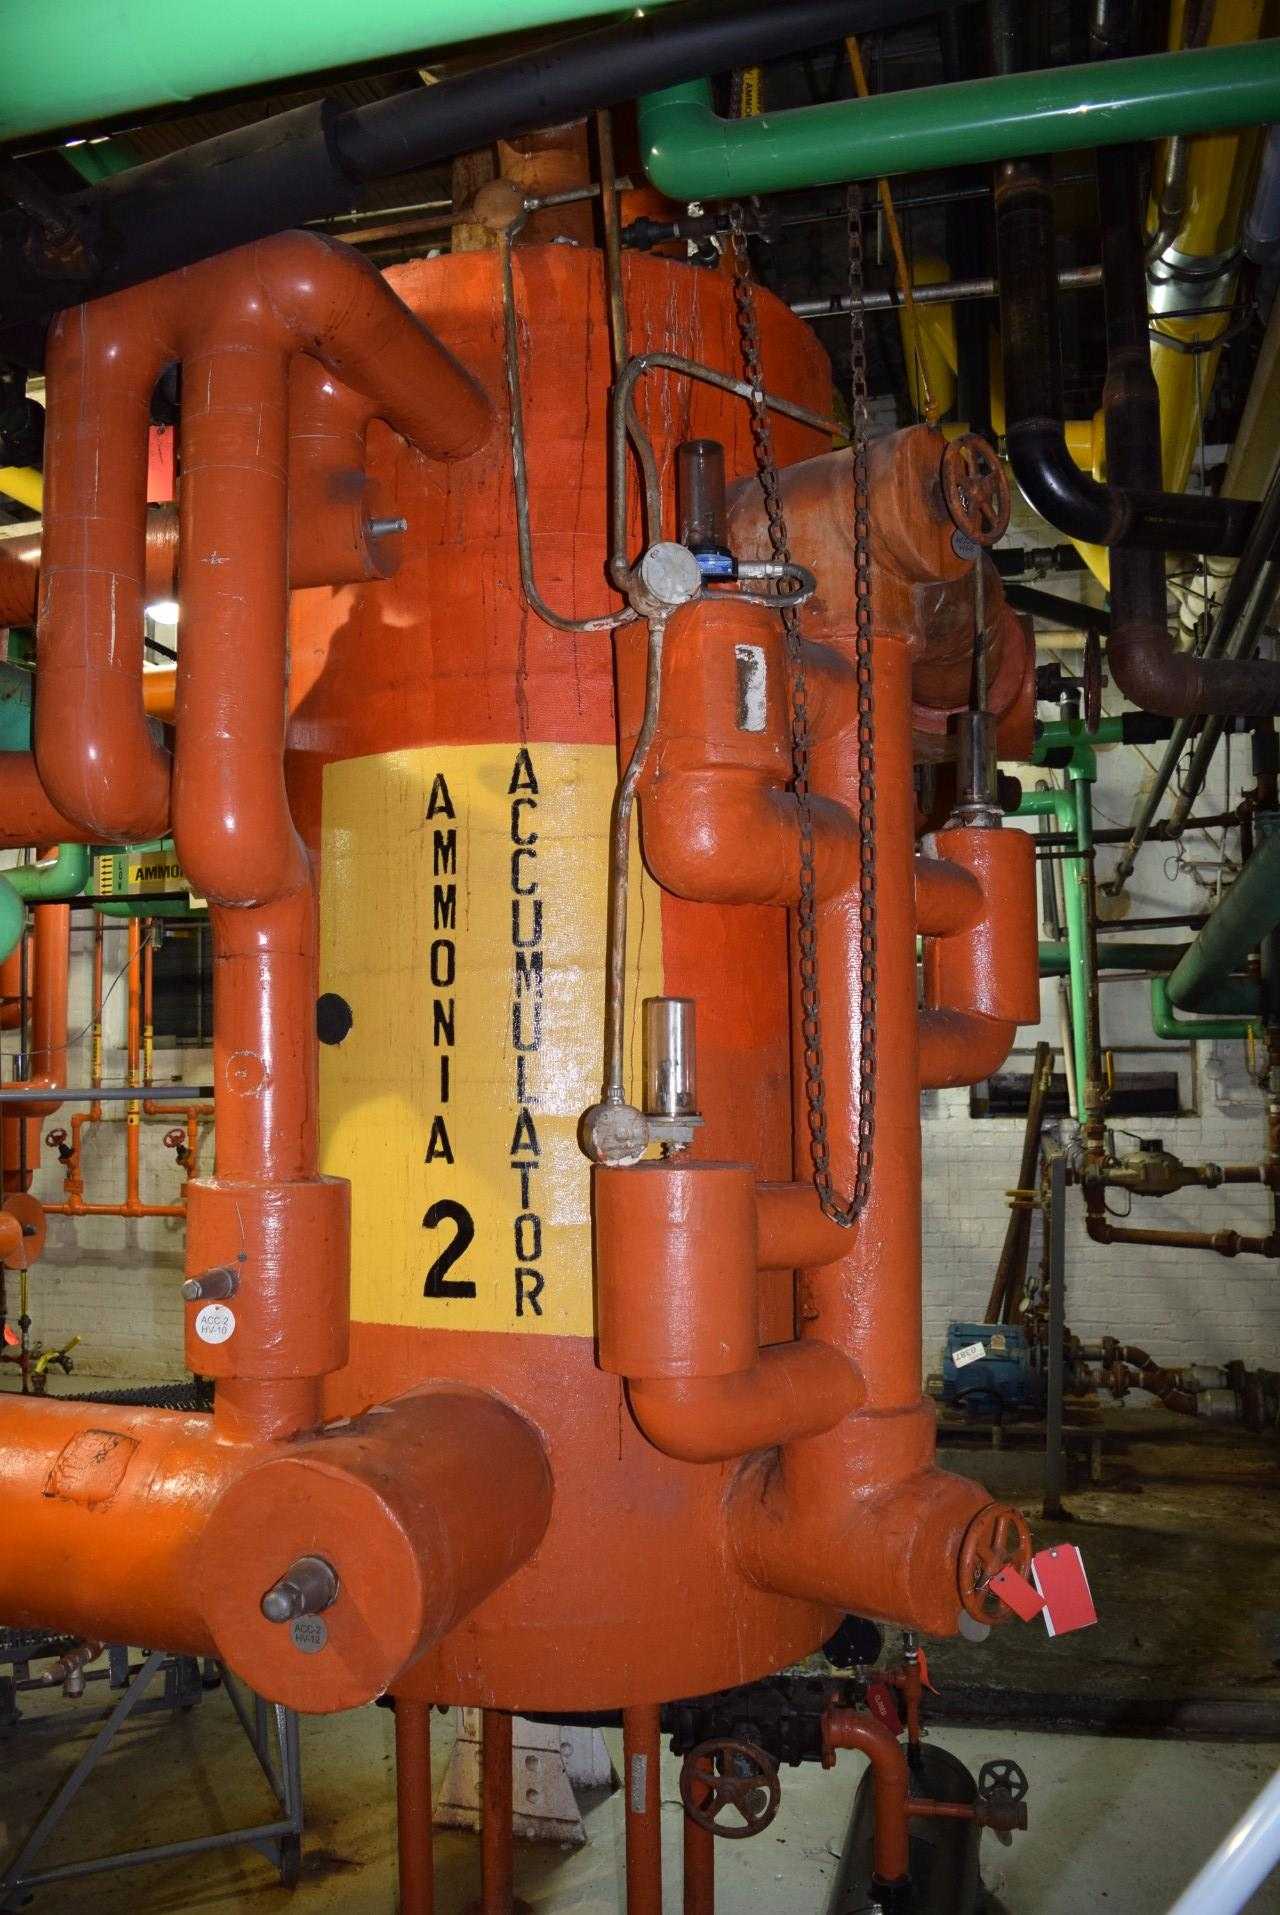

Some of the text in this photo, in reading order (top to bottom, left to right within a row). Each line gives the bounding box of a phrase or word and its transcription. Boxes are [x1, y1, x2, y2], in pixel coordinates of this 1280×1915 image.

[135, 864, 183, 881] AMMO
[425, 773, 456, 1164] AMMONIA
[508, 748, 544, 1317] ACCUMULATOR
[422, 1199, 476, 1298] 2
[201, 1315, 229, 1325] ACC-2
[294, 1623, 321, 1633] ACC-2
